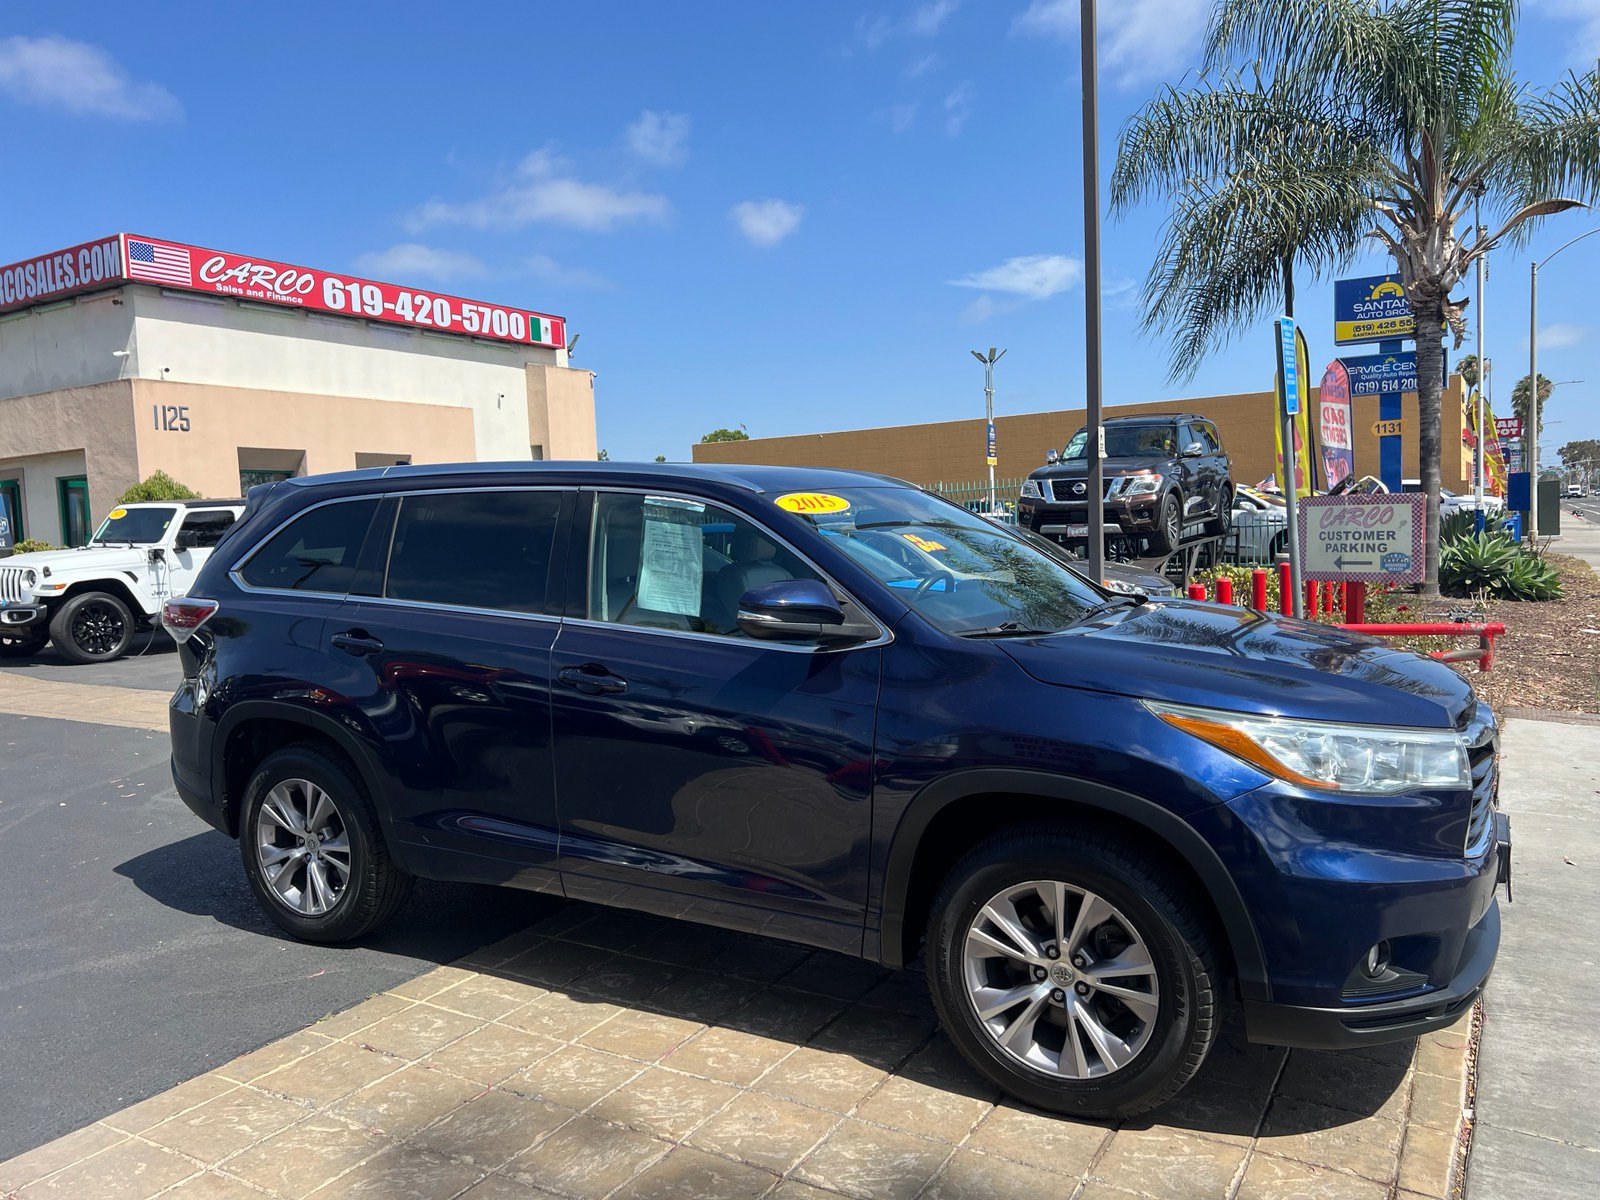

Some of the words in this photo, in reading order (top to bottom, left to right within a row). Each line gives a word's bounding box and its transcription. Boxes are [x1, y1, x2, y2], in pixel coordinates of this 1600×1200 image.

[199, 256, 315, 295] CARCO
[215, 282, 244, 295] Sales
[246, 288, 264, 298] and
[266, 291, 303, 304] Finance
[322, 277, 526, 340] 619-420-5700
[1353, 299, 1410, 312] SANTAN
[1356, 311, 1383, 320] AUTO
[1384, 308, 1412, 317] GROU
[1352, 323, 1375, 333] (619)
[1377, 321, 1397, 330] 426
[1347, 364, 1390, 375] ERVICE
[1392, 361, 1417, 371] CEN
[1354, 381, 1379, 394] (619)
[1381, 379, 1399, 392] 614
[1401, 377, 1418, 390] 20
[153, 405, 191, 432] 1125
[1374, 422, 1402, 434] 1131
[789, 496, 836, 510] 2015
[1319, 505, 1395, 529] CARCO
[1318, 530, 1397, 541] CUSTOMER
[1325, 543, 1388, 553] PARKING
